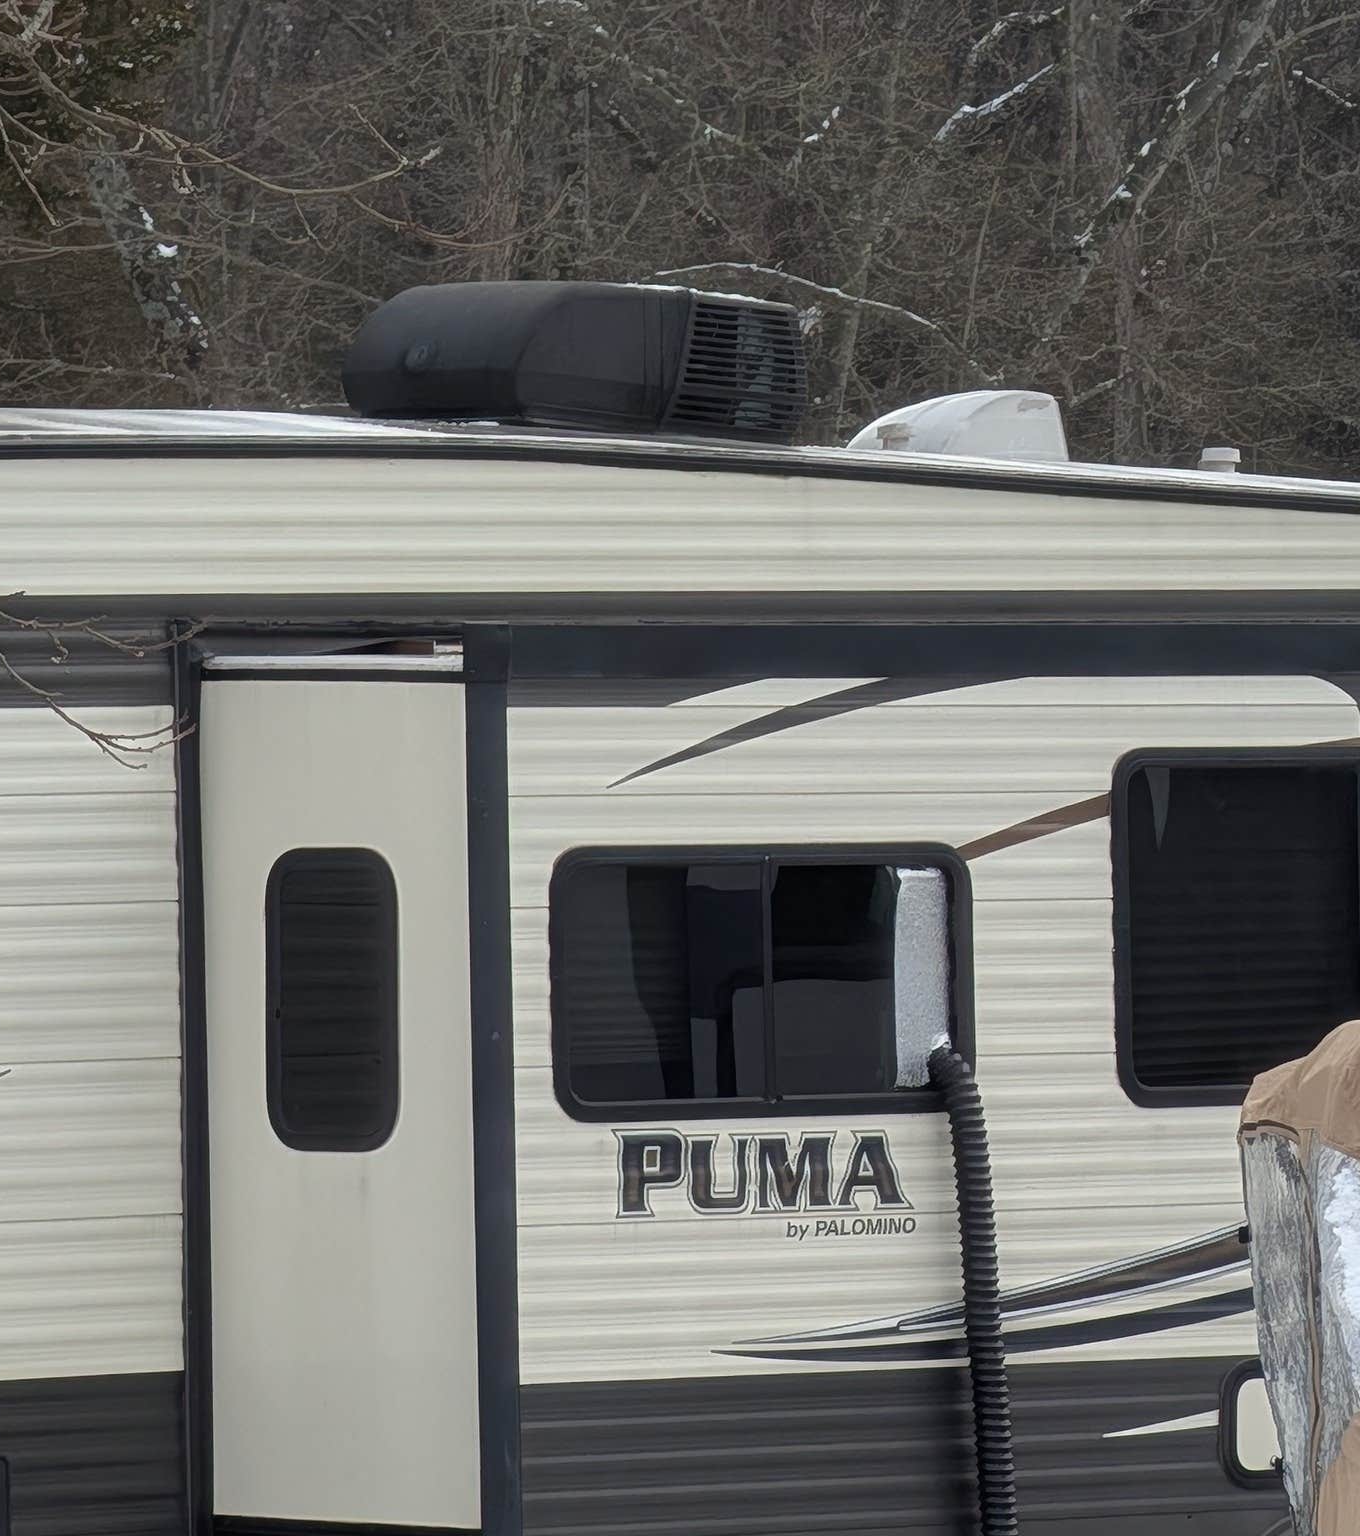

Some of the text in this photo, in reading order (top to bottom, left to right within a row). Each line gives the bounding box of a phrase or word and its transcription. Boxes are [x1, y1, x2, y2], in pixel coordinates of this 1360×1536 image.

[611, 1128, 915, 1219] PUMA
[786, 1217, 917, 1241] by PALOMINO
